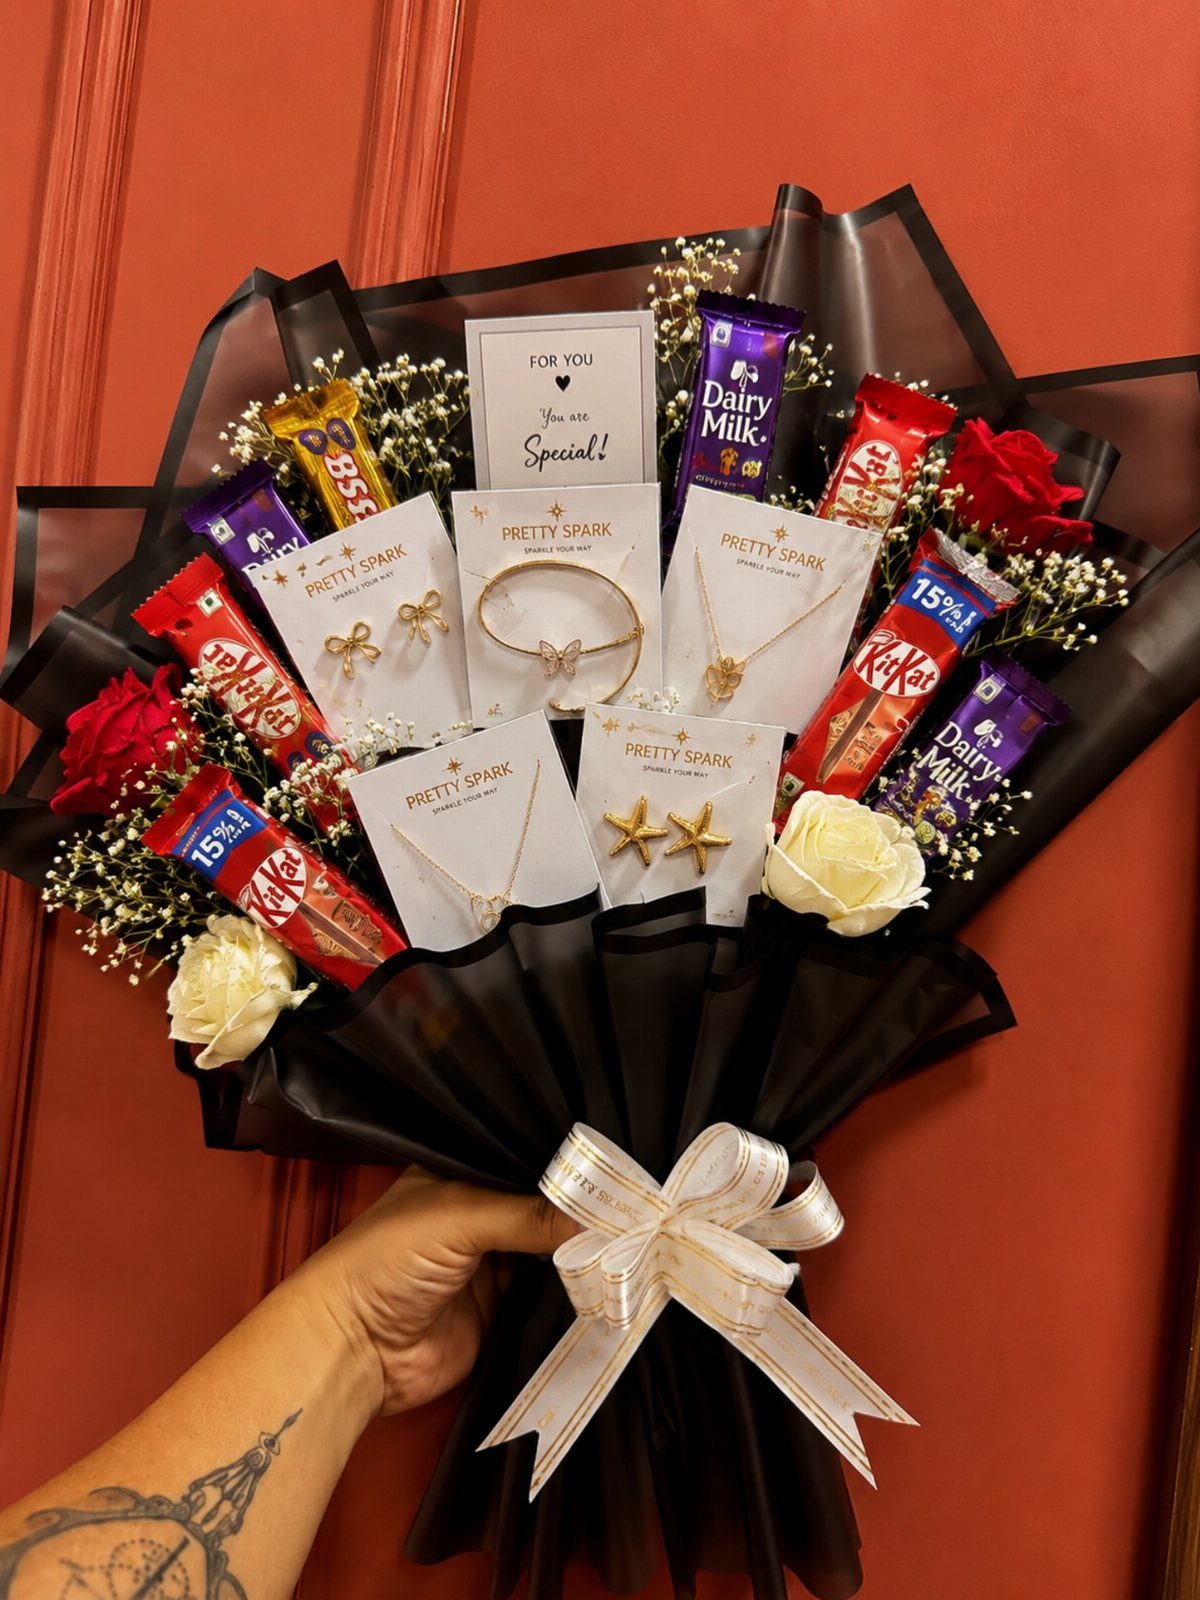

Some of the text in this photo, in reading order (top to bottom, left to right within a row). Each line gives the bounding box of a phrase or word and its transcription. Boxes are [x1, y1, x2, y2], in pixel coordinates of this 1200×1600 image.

[530, 353, 593, 369] FOR YOU
[540, 408, 590, 429] You are
[701, 379, 773, 421] Dairy
[524, 433, 609, 472] Special!
[502, 522, 612, 541] PRETTY SPARK
[524, 546, 554, 555] SPARKLE
[304, 543, 407, 598] PRETTY SPARK
[720, 533, 827, 572] PRETTY SPARK
[857, 641, 937, 696] KitKat
[625, 742, 733, 769] PRETTY SPARK
[935, 721, 1003, 781] Dairy
[405, 761, 513, 810] PRETTY SPARK
[916, 745, 970, 800] Milk
[247, 848, 302, 927] KitKat
